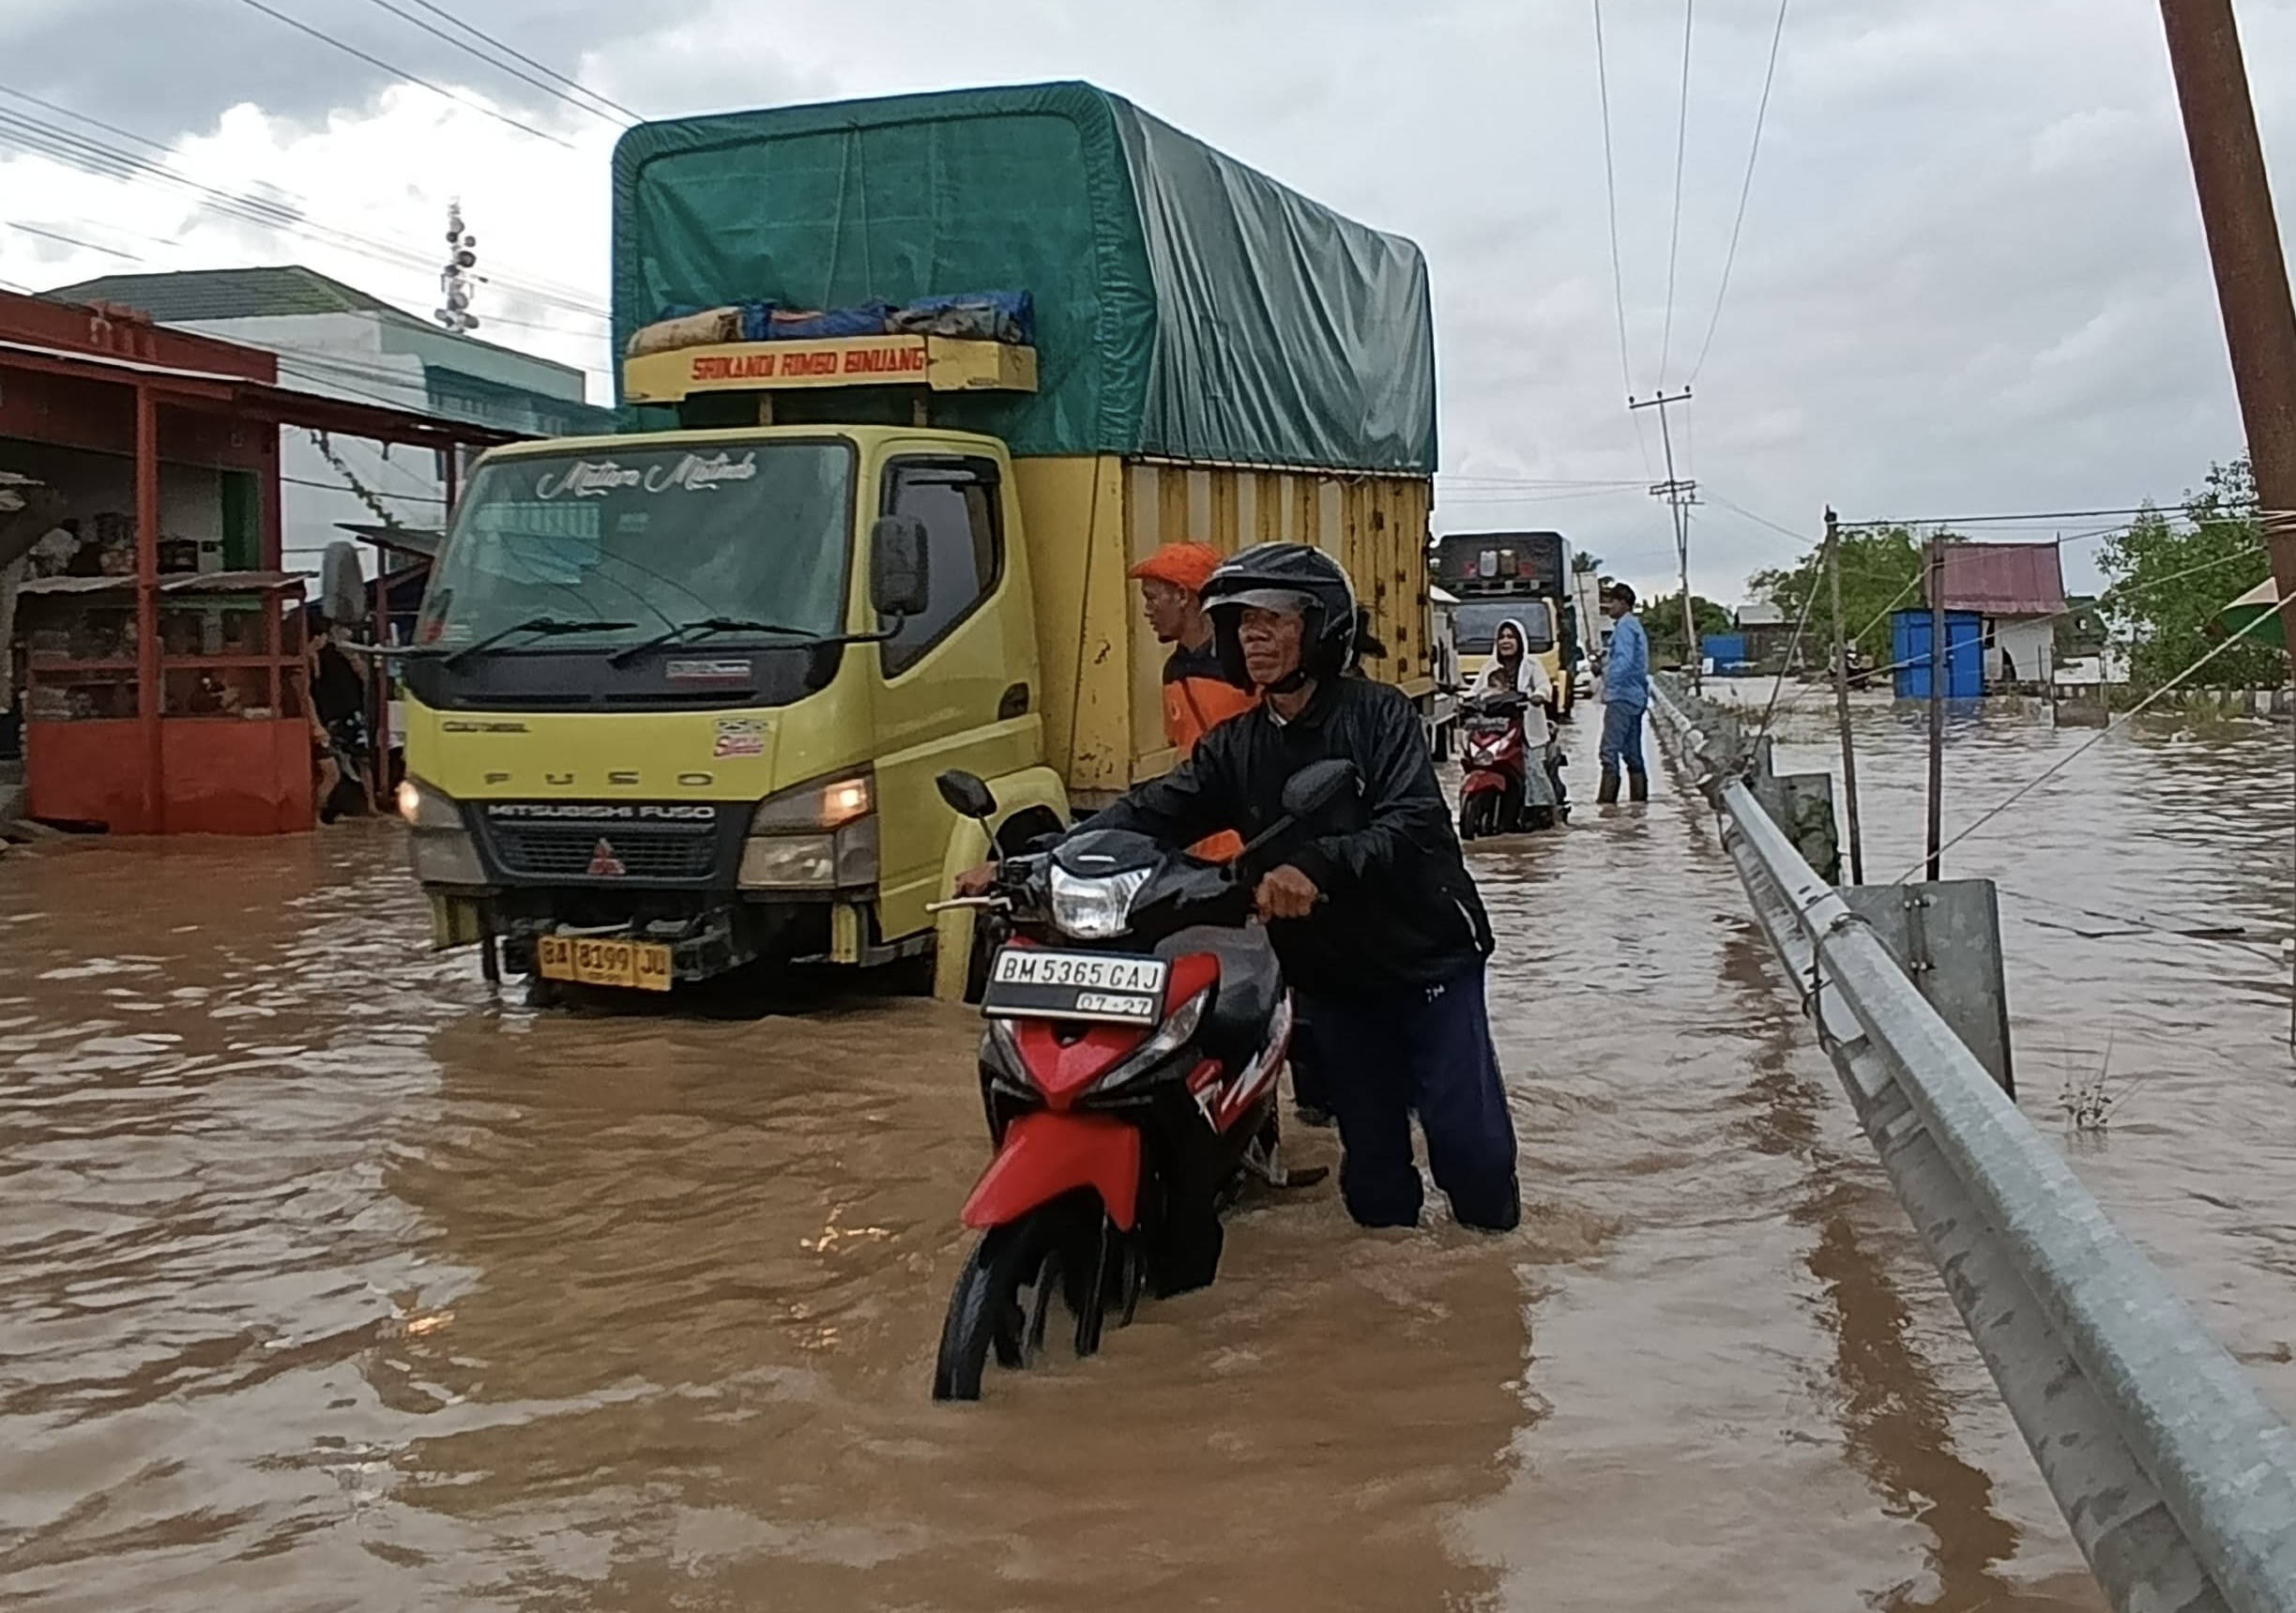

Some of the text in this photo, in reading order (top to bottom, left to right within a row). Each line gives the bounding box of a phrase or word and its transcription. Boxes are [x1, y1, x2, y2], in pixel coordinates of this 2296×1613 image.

[844, 346, 926, 373] BINUANG
[640, 805, 716, 819] FUSO
[1002, 957, 1038, 981] BM
[1042, 958, 1104, 986] 5365
